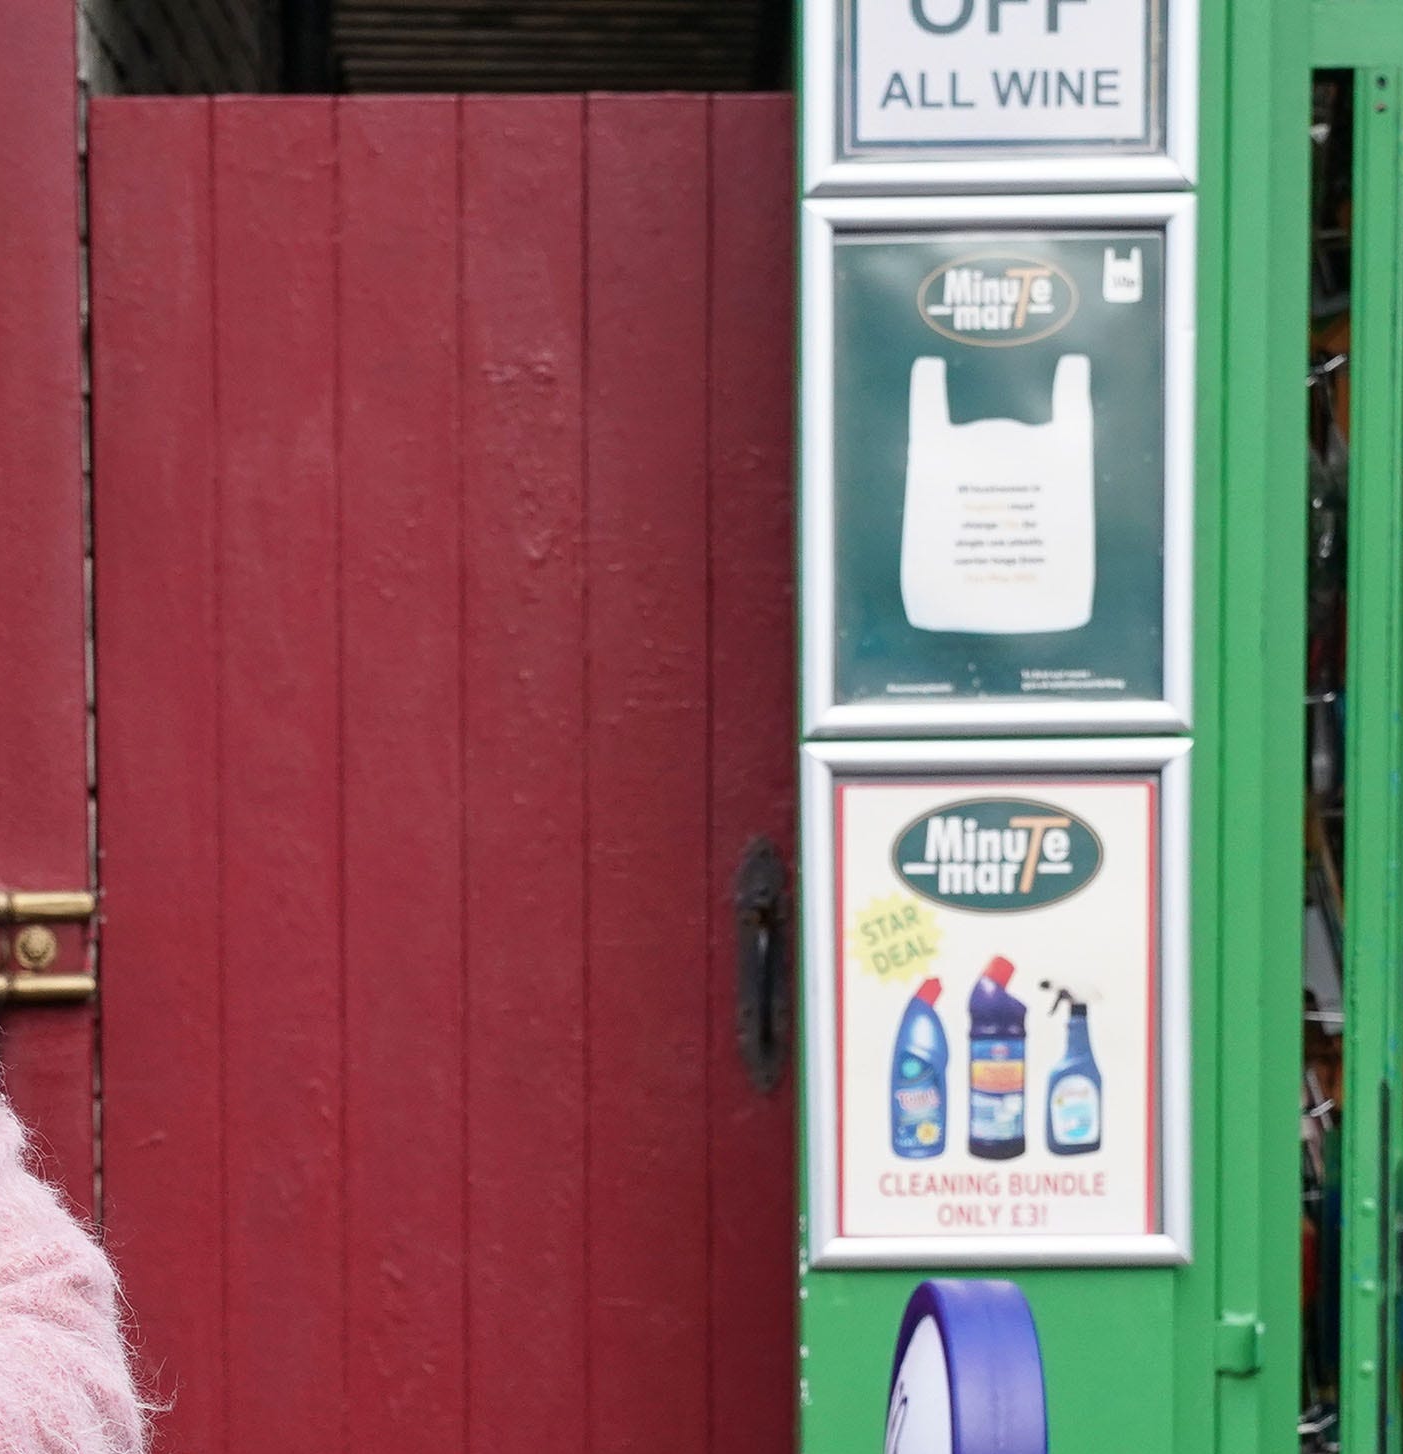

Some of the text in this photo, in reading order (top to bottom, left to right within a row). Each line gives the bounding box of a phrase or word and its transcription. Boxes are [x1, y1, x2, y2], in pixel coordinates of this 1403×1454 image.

[879, 69, 1120, 109] ALL WINE
[859, 905, 921, 947] STAR
[871, 938, 936, 977] DEAL
[878, 1171, 1106, 1197] CLEANING BUNDLE
[937, 1203, 1048, 1228] ONLY £3!
